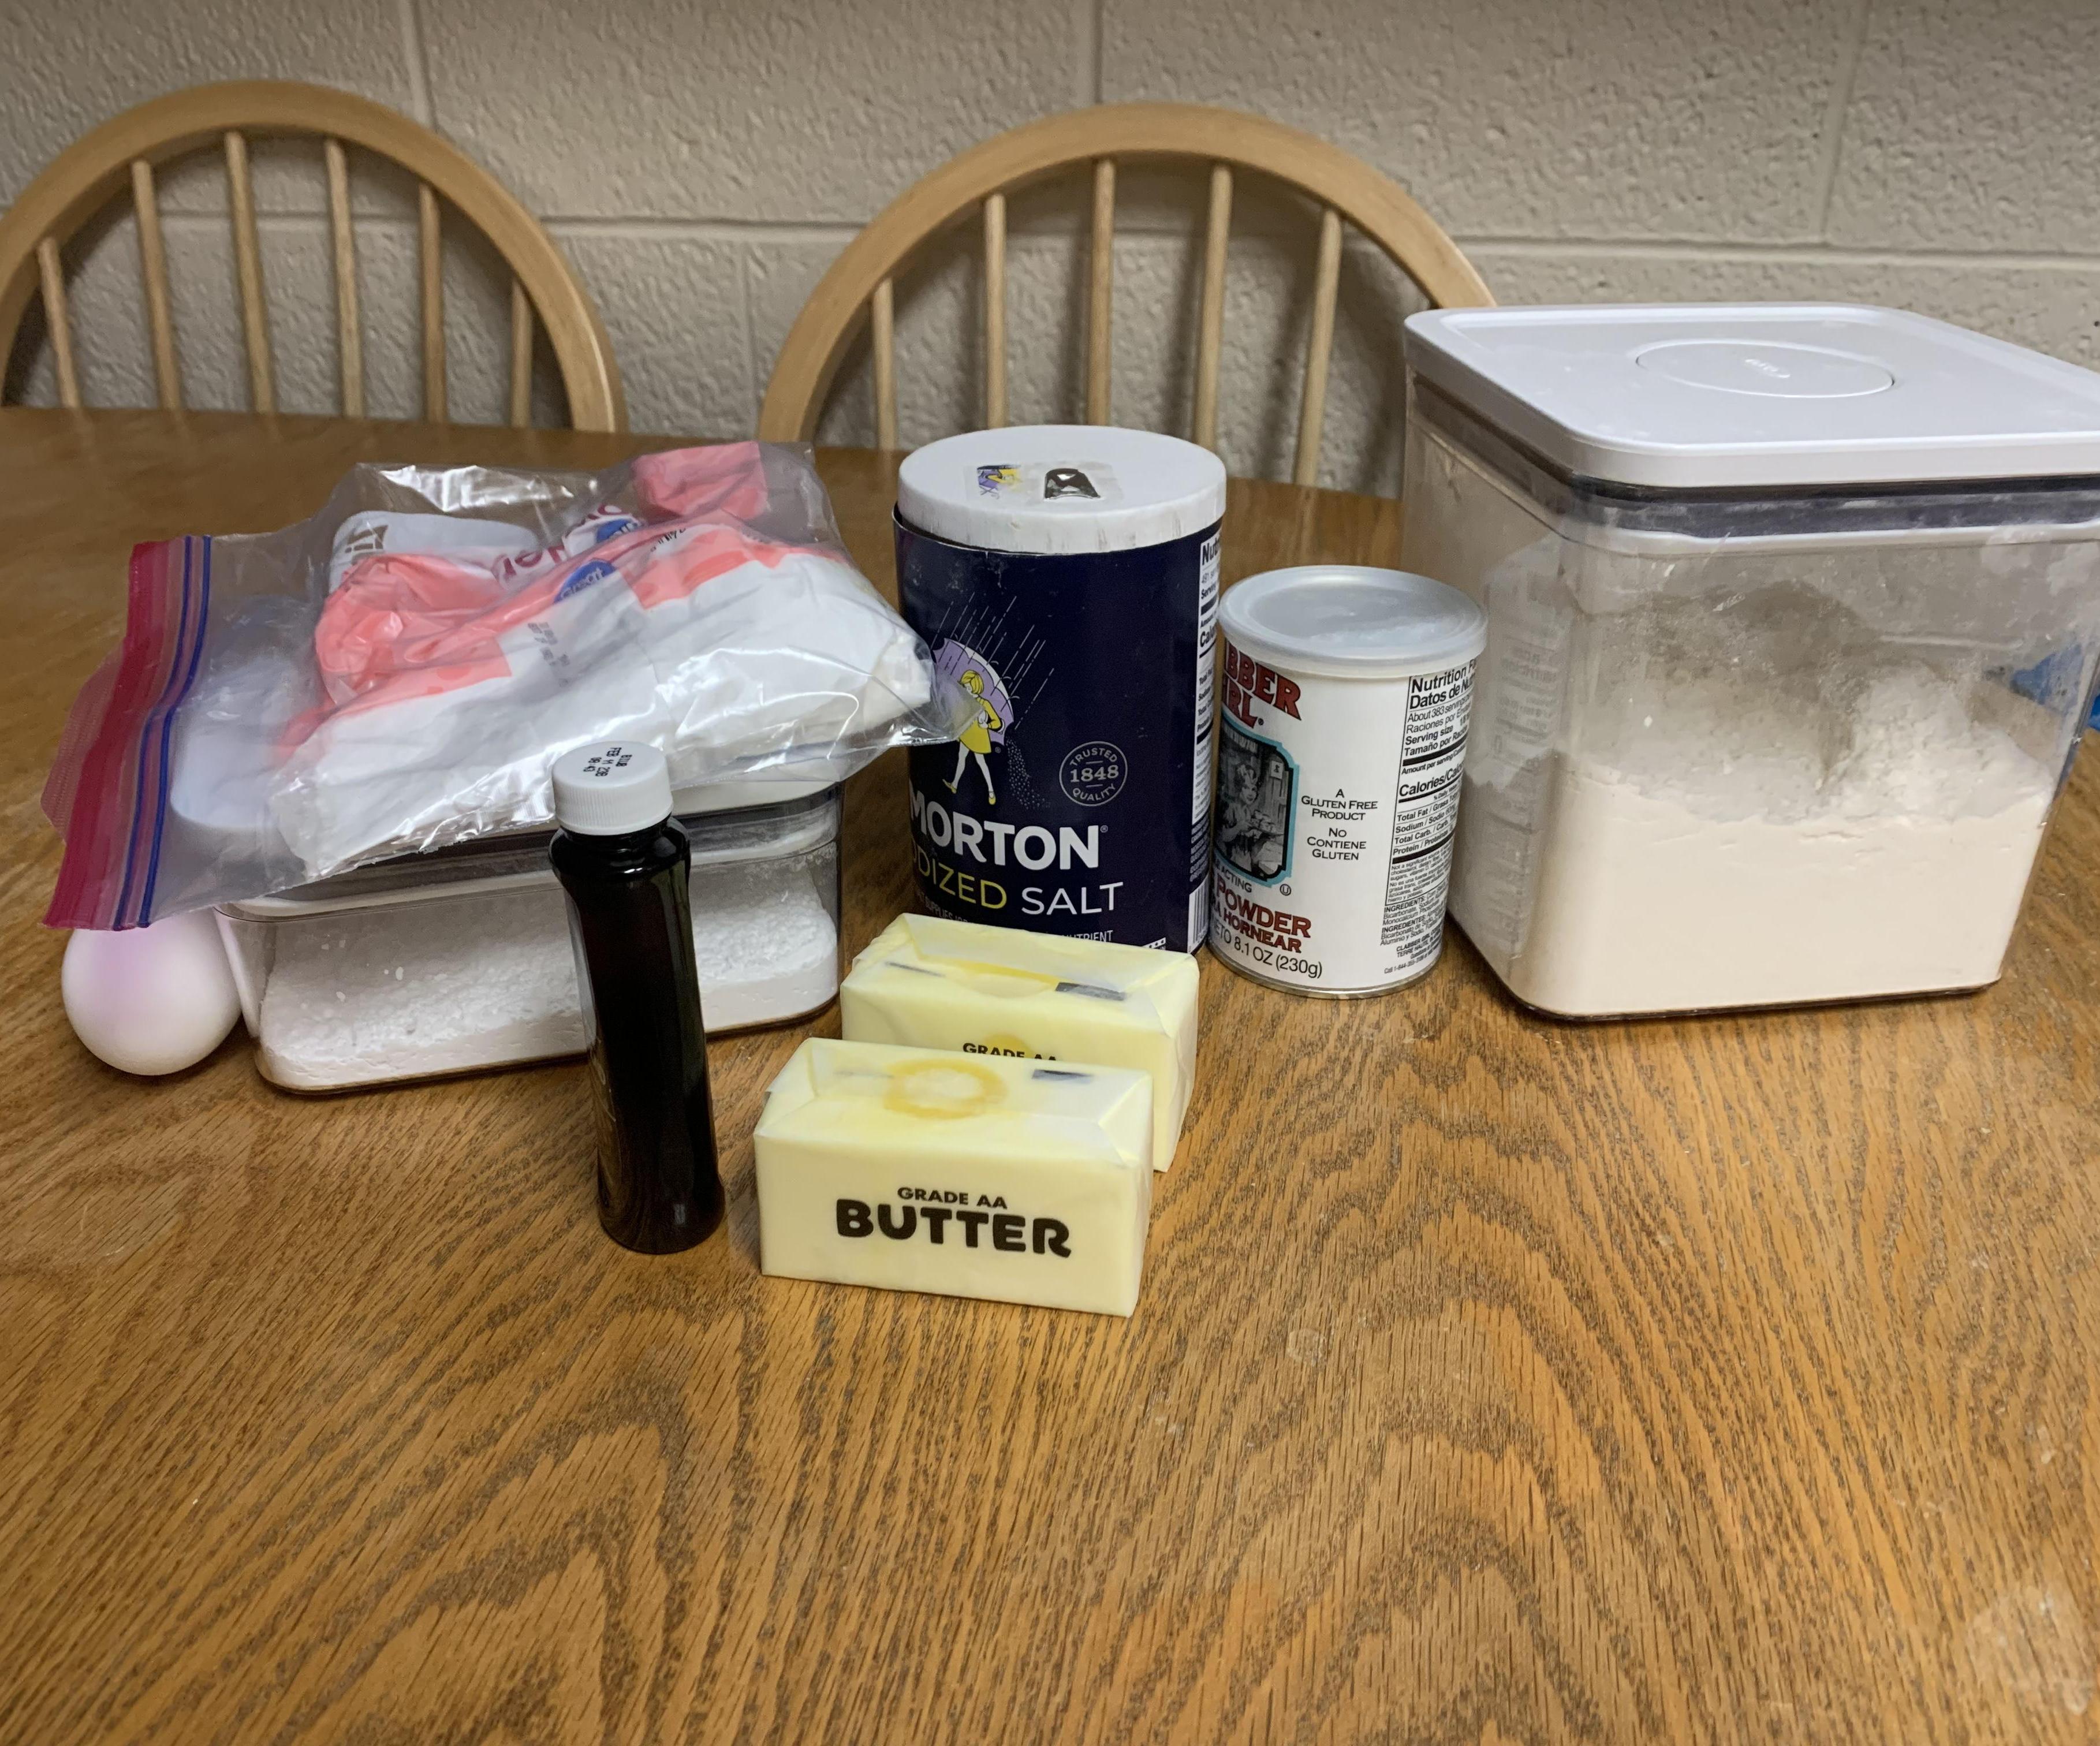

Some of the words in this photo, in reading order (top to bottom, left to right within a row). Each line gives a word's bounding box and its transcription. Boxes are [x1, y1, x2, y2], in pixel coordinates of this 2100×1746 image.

[1412, 667, 1467, 693] Nutrition
[1409, 691, 1446, 709] Datos
[1449, 684, 1460, 699] de
[1407, 710, 1431, 722] About
[1431, 706, 1445, 718] 383
[1407, 719, 1443, 733] Raciones
[1445, 713, 1456, 725] por
[1405, 731, 1438, 745] Serving
[1440, 725, 1453, 736] size
[1404, 742, 1438, 756] Tamaño
[1439, 736, 1452, 749] por
[1069, 748, 1117, 766] TRUSTED
[1070, 764, 1119, 782] 1848
[1401, 764, 1426, 774] Amount
[1426, 762, 1435, 770] per
[1072, 783, 1116, 801] QUALITY
[1336, 789, 1345, 798] A
[1301, 796, 1346, 809] GLUTEN
[1349, 801, 1378, 809] FREE
[1312, 808, 1366, 820] PRODUCT
[1396, 822, 1423, 833] Sodium
[1428, 812, 1445, 824] Sodio
[1397, 812, 1416, 822] Total
[1418, 808, 1428, 817] Fat
[909, 778, 1099, 871] MORTON
[1329, 827, 1347, 837] NO
[1307, 837, 1367, 849] CONTIENE
[1394, 834, 1413, 844] Total
[1415, 829, 1431, 840] Carb.
[1312, 849, 1359, 860] GLUTEN
[1393, 844, 1419, 855] Protein
[1022, 882, 1123, 916] SALT
[1217, 872, 1311, 938] POWDER
[1224, 907, 1301, 953] HORNEAR
[1234, 936, 1249, 956] 8.1
[1253, 946, 1273, 965] OZ
[1275, 954, 1322, 979] (230g)
[896, 1187, 969, 1207] GRADE
[976, 1193, 1008, 1210] AA
[835, 1197, 1072, 1259] BUTTER
